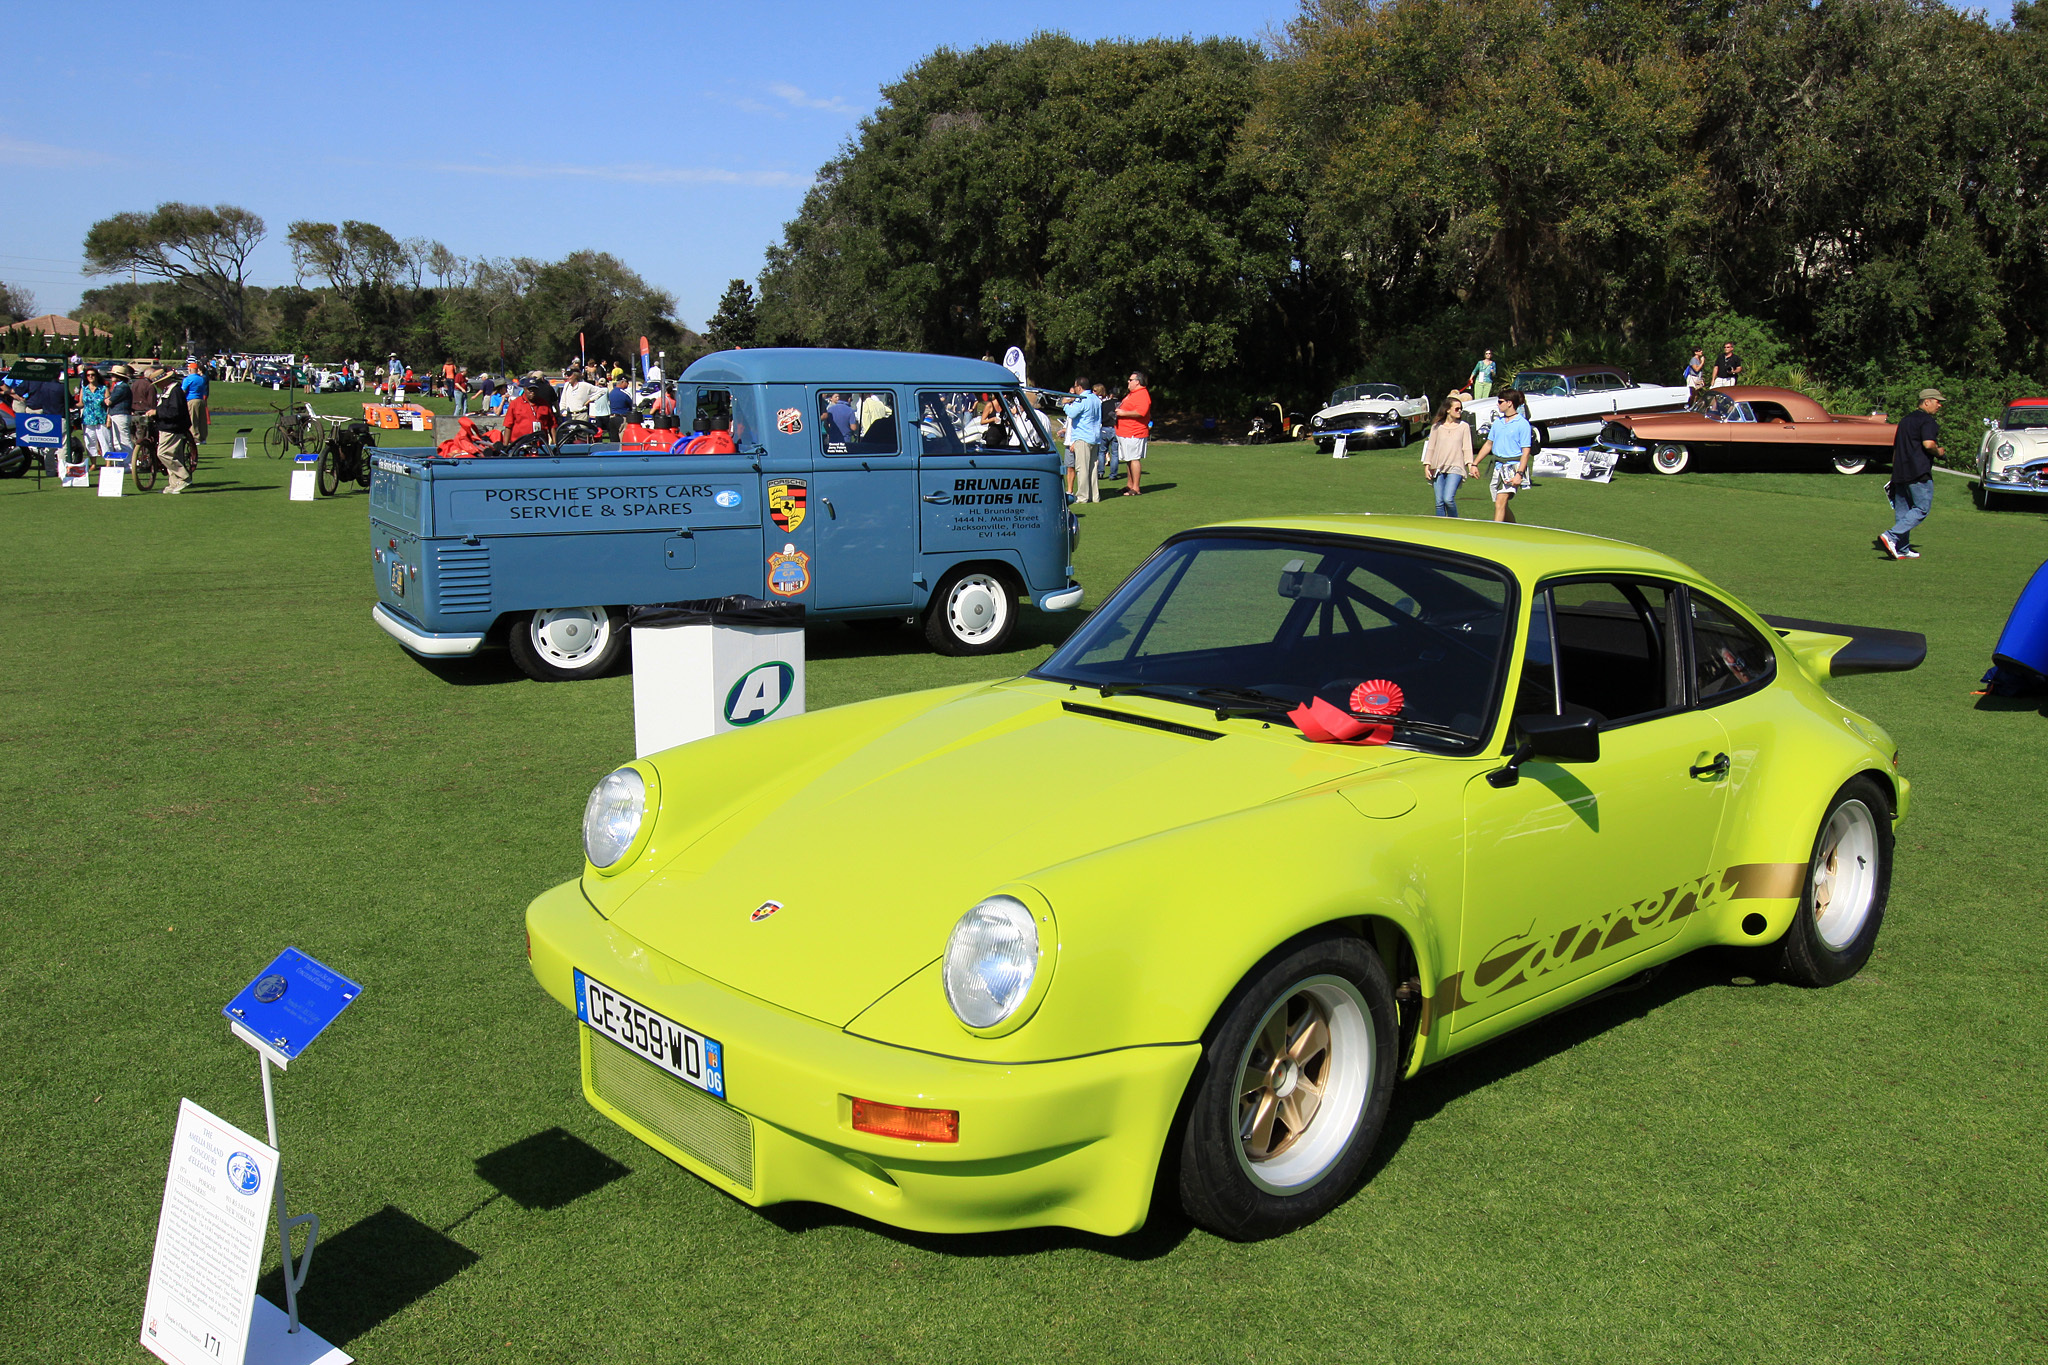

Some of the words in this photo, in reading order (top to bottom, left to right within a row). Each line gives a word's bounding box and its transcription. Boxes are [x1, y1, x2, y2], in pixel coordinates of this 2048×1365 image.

[485, 488, 578, 502] PORSCHE
[586, 486, 658, 500] SPORTS
[665, 485, 713, 498] CARS
[954, 478, 1040, 490] BRUNDAGE
[952, 494, 1013, 505] MOTORS
[1018, 493, 1042, 504] INC.
[510, 505, 592, 519] SERVICE
[600, 505, 615, 517] &
[623, 503, 692, 516] SPARES
[729, 666, 780, 720] A
[1460, 868, 1740, 1004] Carrera
[580, 1001, 584, 1012] F
[707, 1068, 722, 1091] 06
[203, 1128, 212, 1139] THE
[188, 1132, 206, 1147] AMELIA
[206, 1140, 224, 1158] ISLAND
[191, 1144, 217, 1166] CONCOURS
[177, 1174, 192, 1187] STEVEN
[192, 1182, 206, 1196] HARRIS
[226, 1205, 234, 1215] NEW
[199, 1178, 216, 1193] PORSCHE
[204, 1333, 220, 1357] 171
